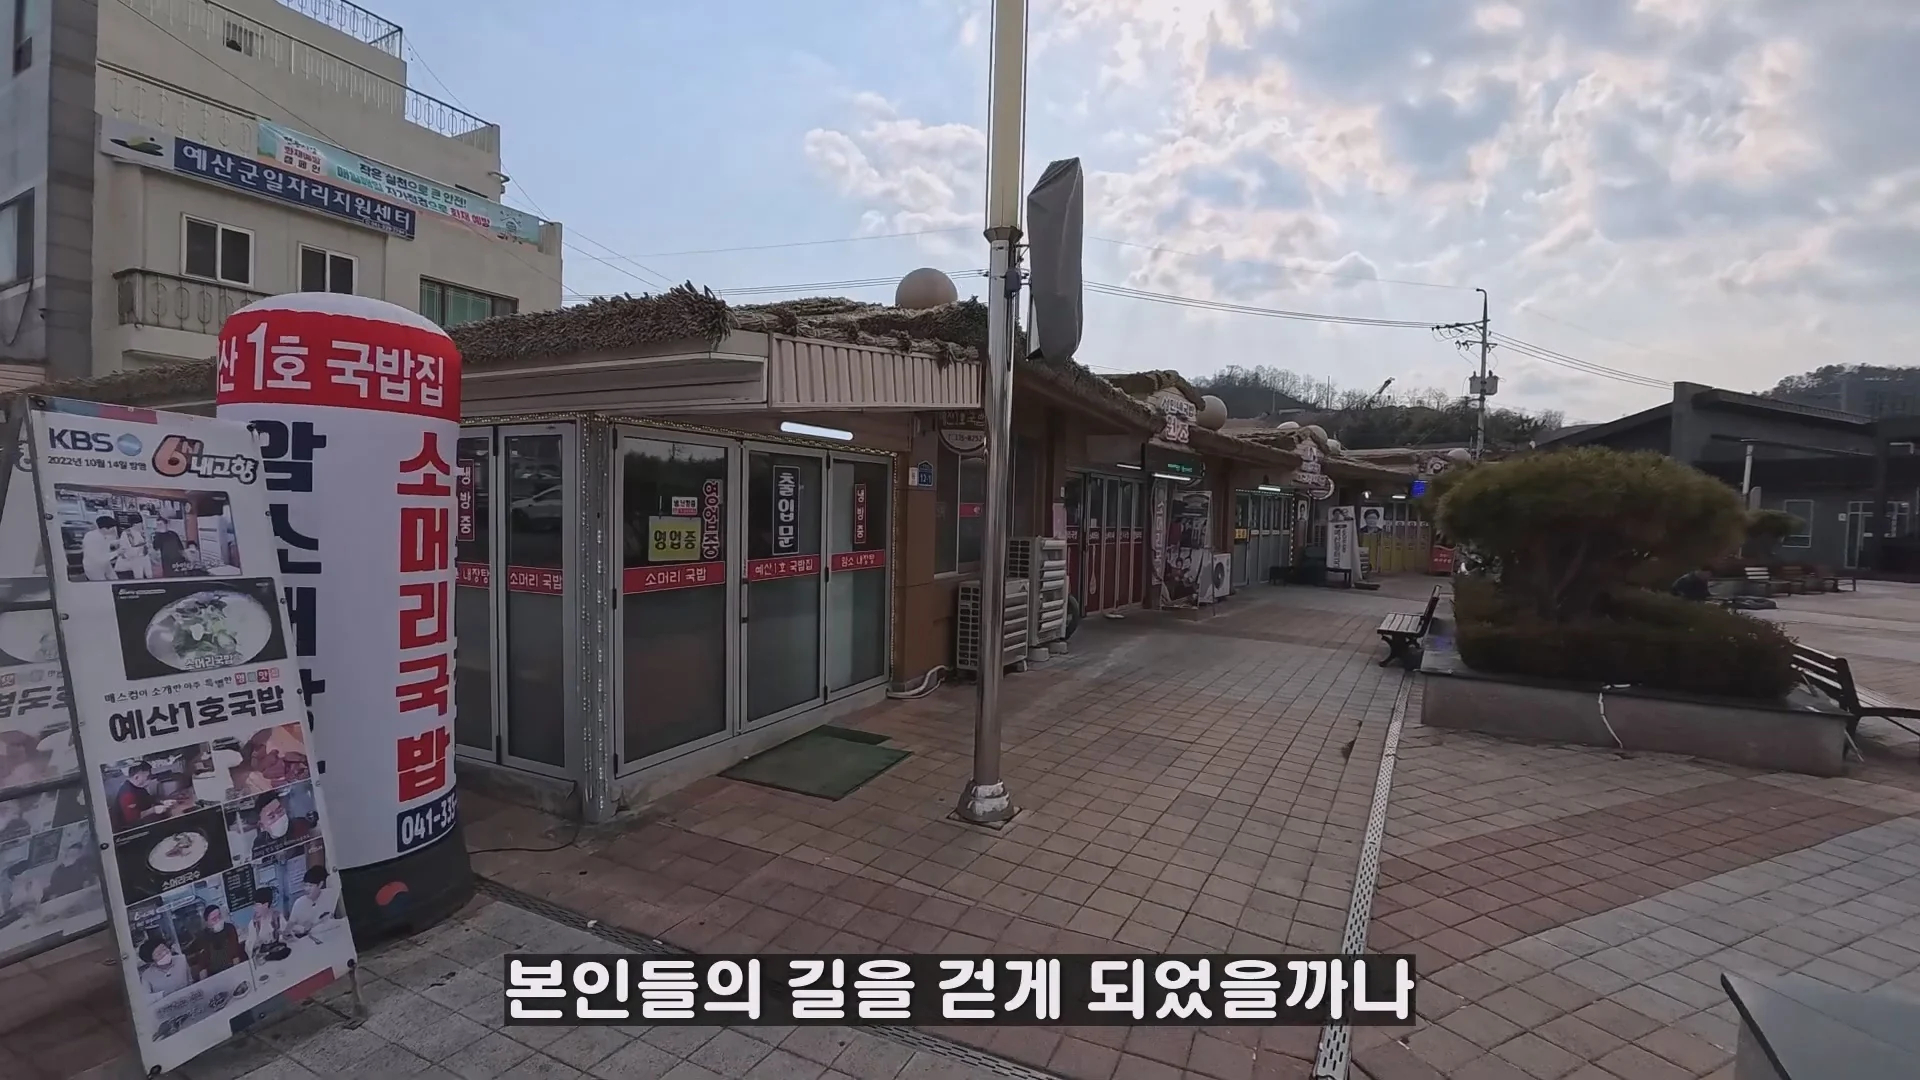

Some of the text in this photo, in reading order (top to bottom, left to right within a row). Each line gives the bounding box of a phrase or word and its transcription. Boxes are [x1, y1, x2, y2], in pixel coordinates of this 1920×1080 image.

[183, 145, 410, 231] 예산군일자리지원센터
[359, 163, 382, 181] 작은
[385, 173, 429, 197] 실천으로
[431, 186, 442, 200] 큰
[449, 207, 471, 223] 화재
[472, 212, 491, 228] 예방
[217, 336, 238, 392] 산
[326, 340, 443, 407] 국밥집
[49, 427, 114, 452] KBS
[48, 456, 82, 467] 2022년
[85, 458, 106, 469] 10월
[107, 461, 128, 470] 14일
[189, 454, 260, 485] 내고향
[702, 479, 720, 559] 영업중
[777, 472, 796, 548] 출입문
[654, 530, 696, 550] 영업중
[462, 567, 490, 584] 내장탕
[644, 567, 707, 586] 소머리 국밥
[789, 558, 813, 572] 국밥집
[510, 572, 562, 590] 소머리 국밥
[394, 432, 452, 803] 소머리국밥
[184, 653, 233, 671] 소머리국밥
[104, 690, 148, 704] 매스컴이
[235, 667, 280, 686] 명맛집
[108, 685, 284, 743] 예산1호국밥
